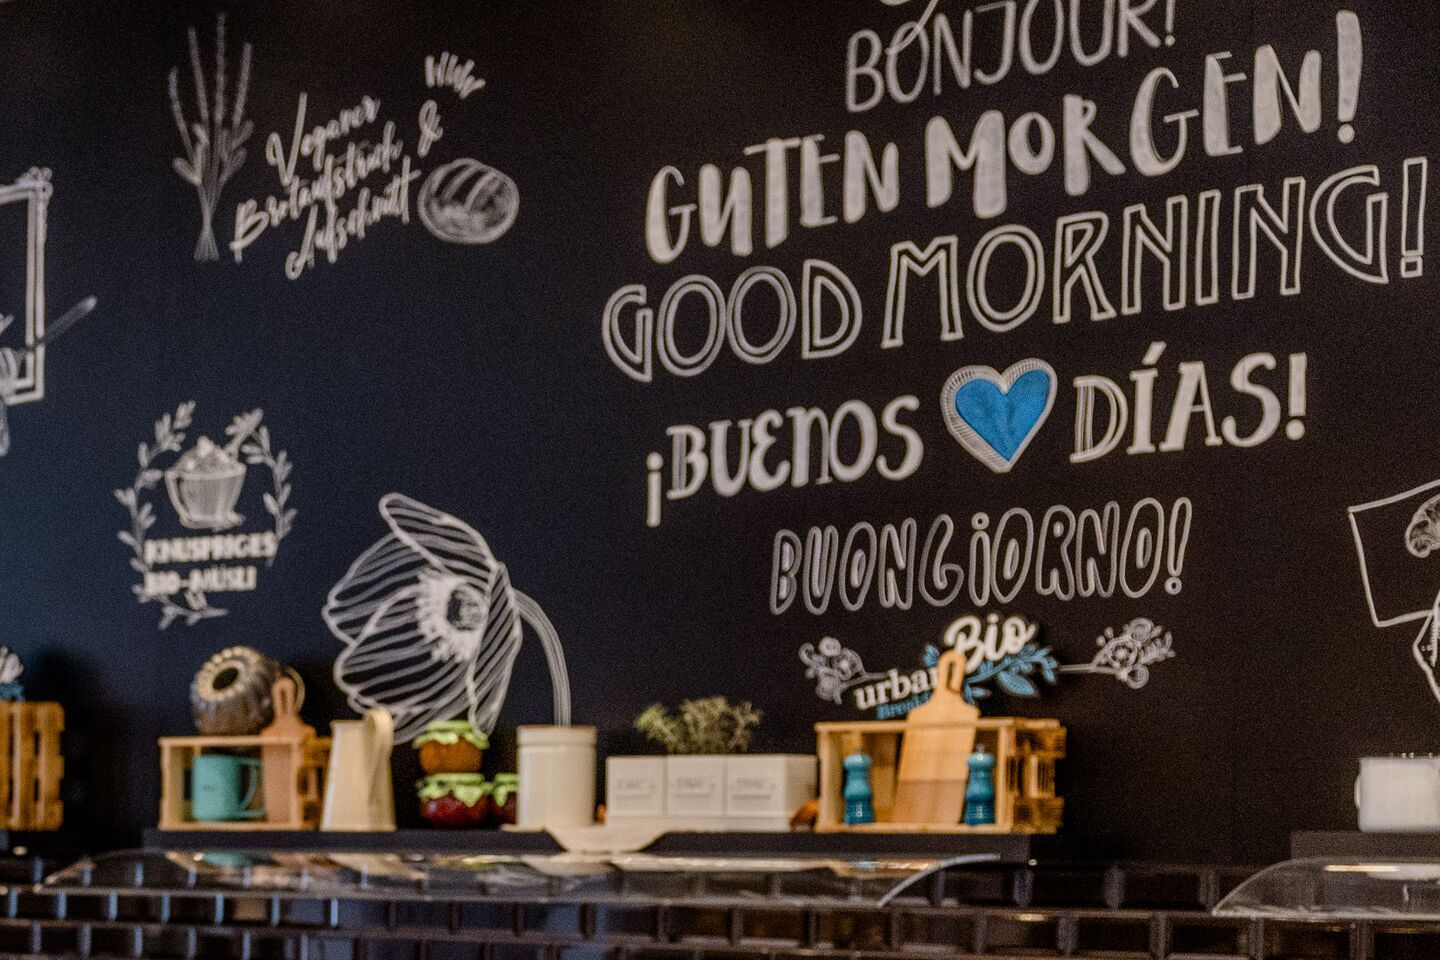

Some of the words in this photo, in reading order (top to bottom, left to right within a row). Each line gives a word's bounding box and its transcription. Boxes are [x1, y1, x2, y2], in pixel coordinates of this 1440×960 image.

[846, 0, 1176, 112] BONJOUR!
[645, 131, 900, 264] GUTEN
[925, 10, 1363, 219] MORGEN!
[602, 259, 863, 382] GOOD
[881, 157, 1429, 349] MORNING!
[1070, 342, 1308, 464] DÍAS!
[943, 613, 1037, 673] Bio
